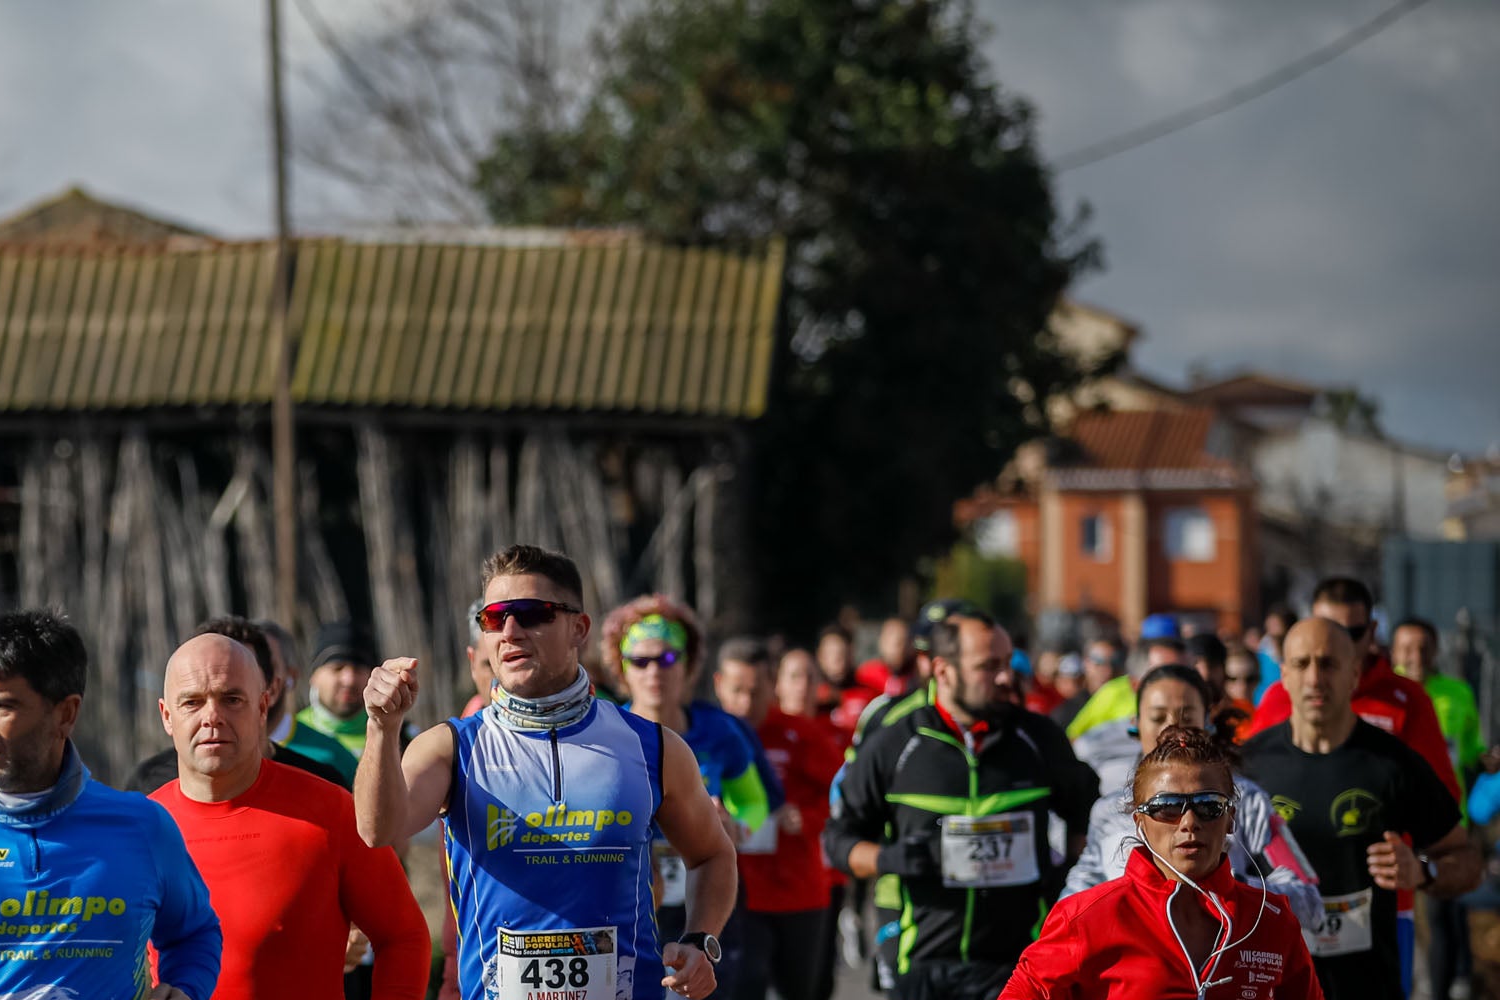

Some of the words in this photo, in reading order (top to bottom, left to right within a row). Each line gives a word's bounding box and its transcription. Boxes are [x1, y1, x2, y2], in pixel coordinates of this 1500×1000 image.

[525, 804, 632, 831] olimpo
[521, 831, 590, 845] deportes
[970, 836, 1013, 861] 237
[525, 856, 559, 865] TRAIL
[562, 855, 571, 864] &
[574, 853, 625, 863] RUNNING
[0, 890, 126, 921] olimpo
[515, 936, 525, 949] VII
[525, 935, 570, 944] CARRERA
[0, 950, 38, 961] TRAIL
[42, 950, 52, 960] &
[56, 947, 113, 959] RUNNING
[1240, 950, 1252, 963] VII
[1252, 950, 1283, 960] CARRERA
[1252, 957, 1283, 968] POPULAR
[521, 958, 589, 989] 438
